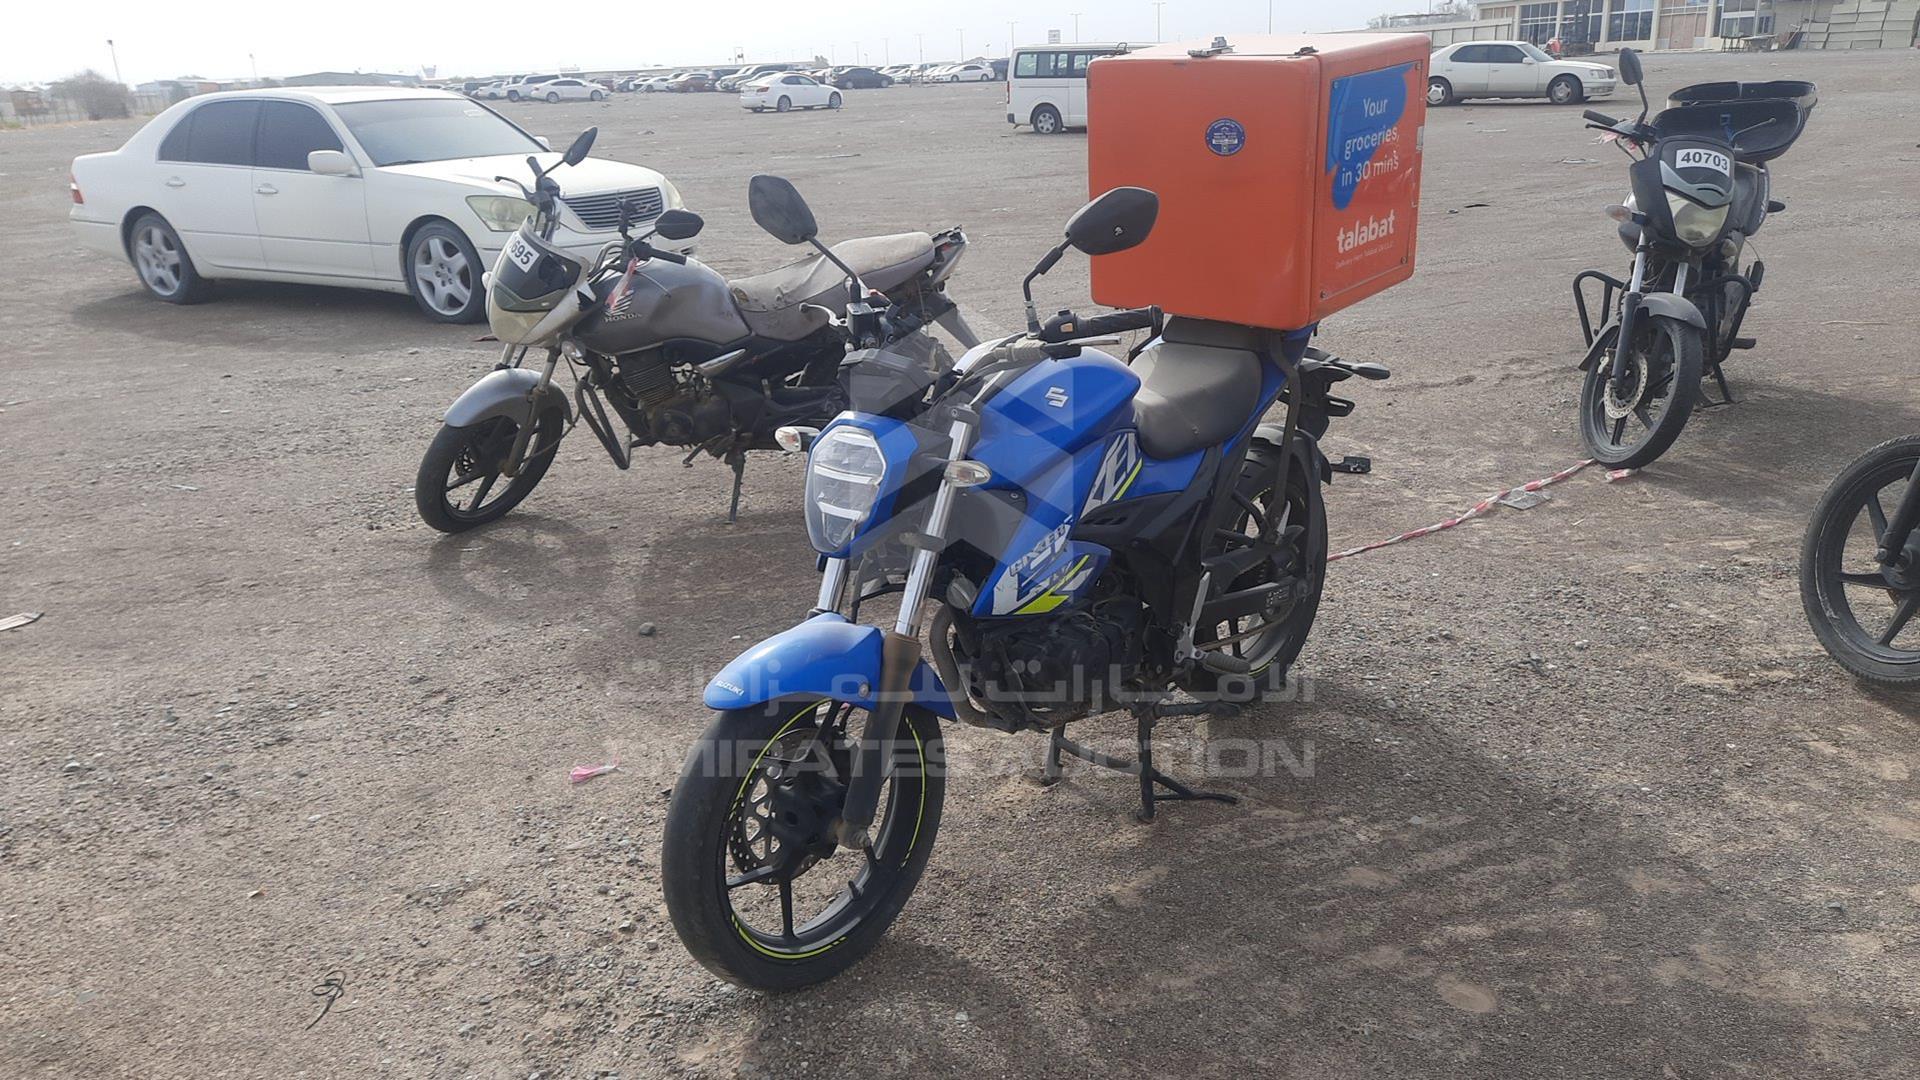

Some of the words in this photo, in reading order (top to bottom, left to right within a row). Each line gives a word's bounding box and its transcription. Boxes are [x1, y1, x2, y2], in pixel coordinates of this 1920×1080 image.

[1363, 97, 1388, 118] Your
[1681, 151, 1728, 171] 40703
[1341, 167, 1352, 187] in
[1355, 160, 1371, 182] 30
[1337, 208, 1395, 254] talabat
[603, 312, 643, 323] HONDA
[715, 679, 745, 697] SUZUKI
